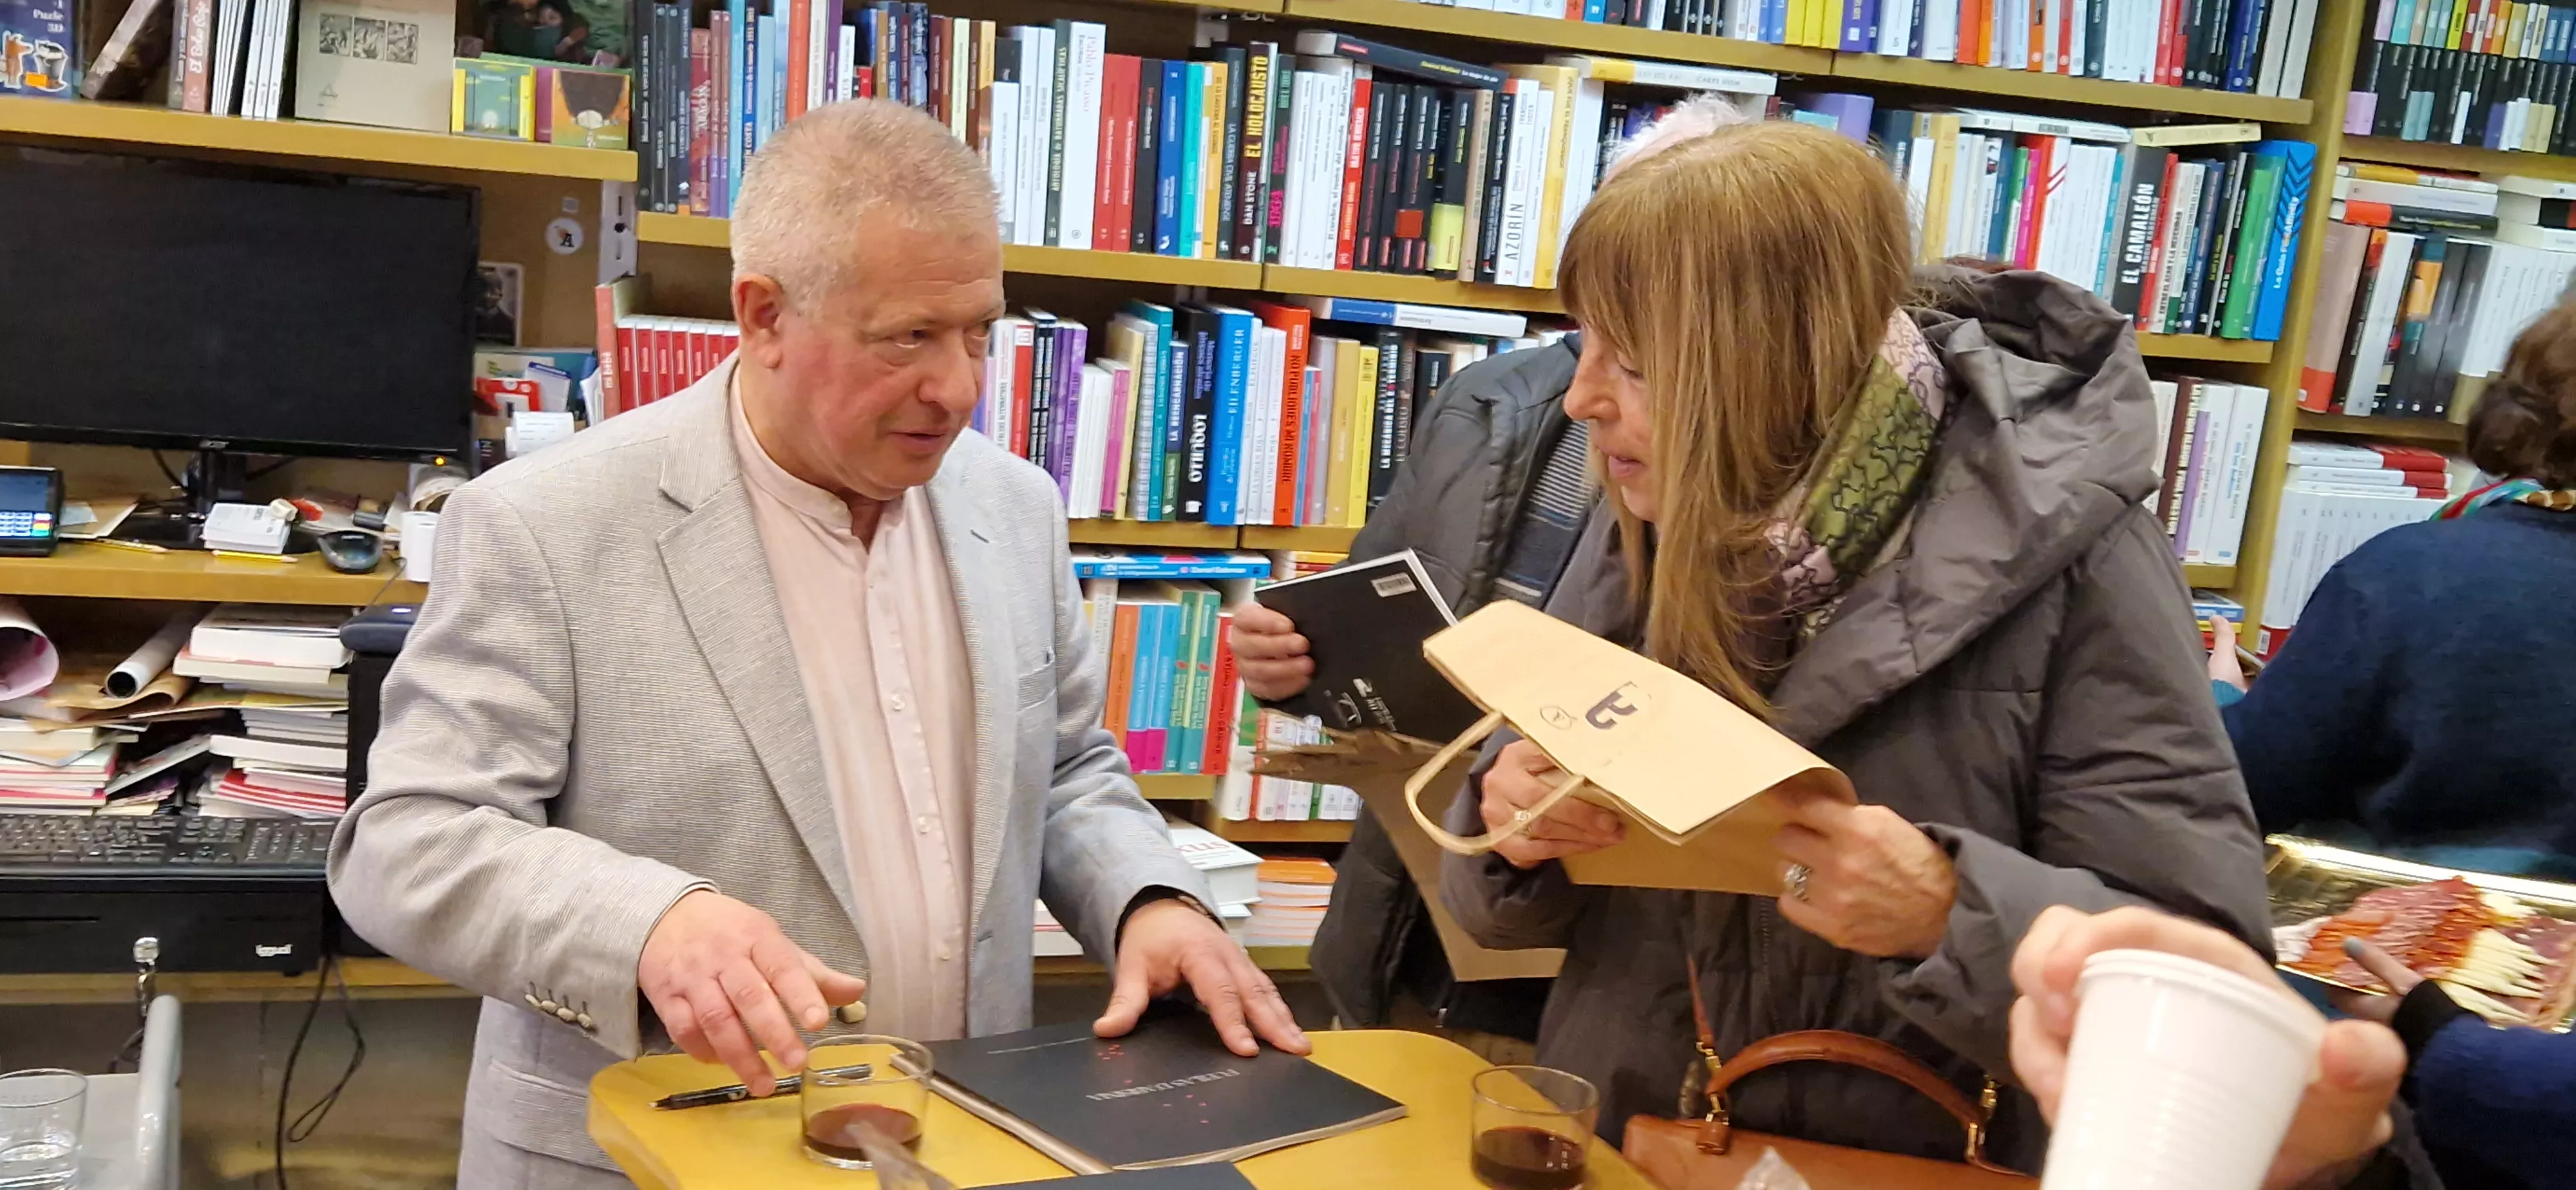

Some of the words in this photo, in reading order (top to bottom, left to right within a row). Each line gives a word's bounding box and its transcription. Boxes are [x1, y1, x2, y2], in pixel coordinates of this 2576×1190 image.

[1084, 35, 1098, 68] Pablo
[1247, 56, 1269, 136] HOLOCAUSTO
[1338, 92, 1347, 117] Rafael
[744, 122, 753, 148] COSTA
[1245, 141, 1262, 158] EL
[1244, 171, 1257, 203] STONE
[1242, 204, 1254, 225] DAN
[2124, 183, 2155, 263] CAMALEÓN
[560, 232, 575, 248] A
[1504, 203, 1524, 261] AZORÍN
[2121, 269, 2139, 284] EL
[2272, 277, 2282, 288] La
[1227, 329, 1245, 413] EILENBERGER
[1289, 354, 1302, 370] NO
[1384, 345, 1397, 396] ETERMINIO
[1170, 352, 1185, 427] REENCARNACIÓN
[1382, 399, 1394, 413] DEL
[1170, 430, 1179, 442] LA
[1188, 413, 1208, 482] LOQUILLO
[1284, 430, 1295, 442] MI
[1380, 413, 1393, 457] MECÁNICA
[1282, 443, 1294, 484] NOMBRE
[1380, 458, 1391, 469] LA
